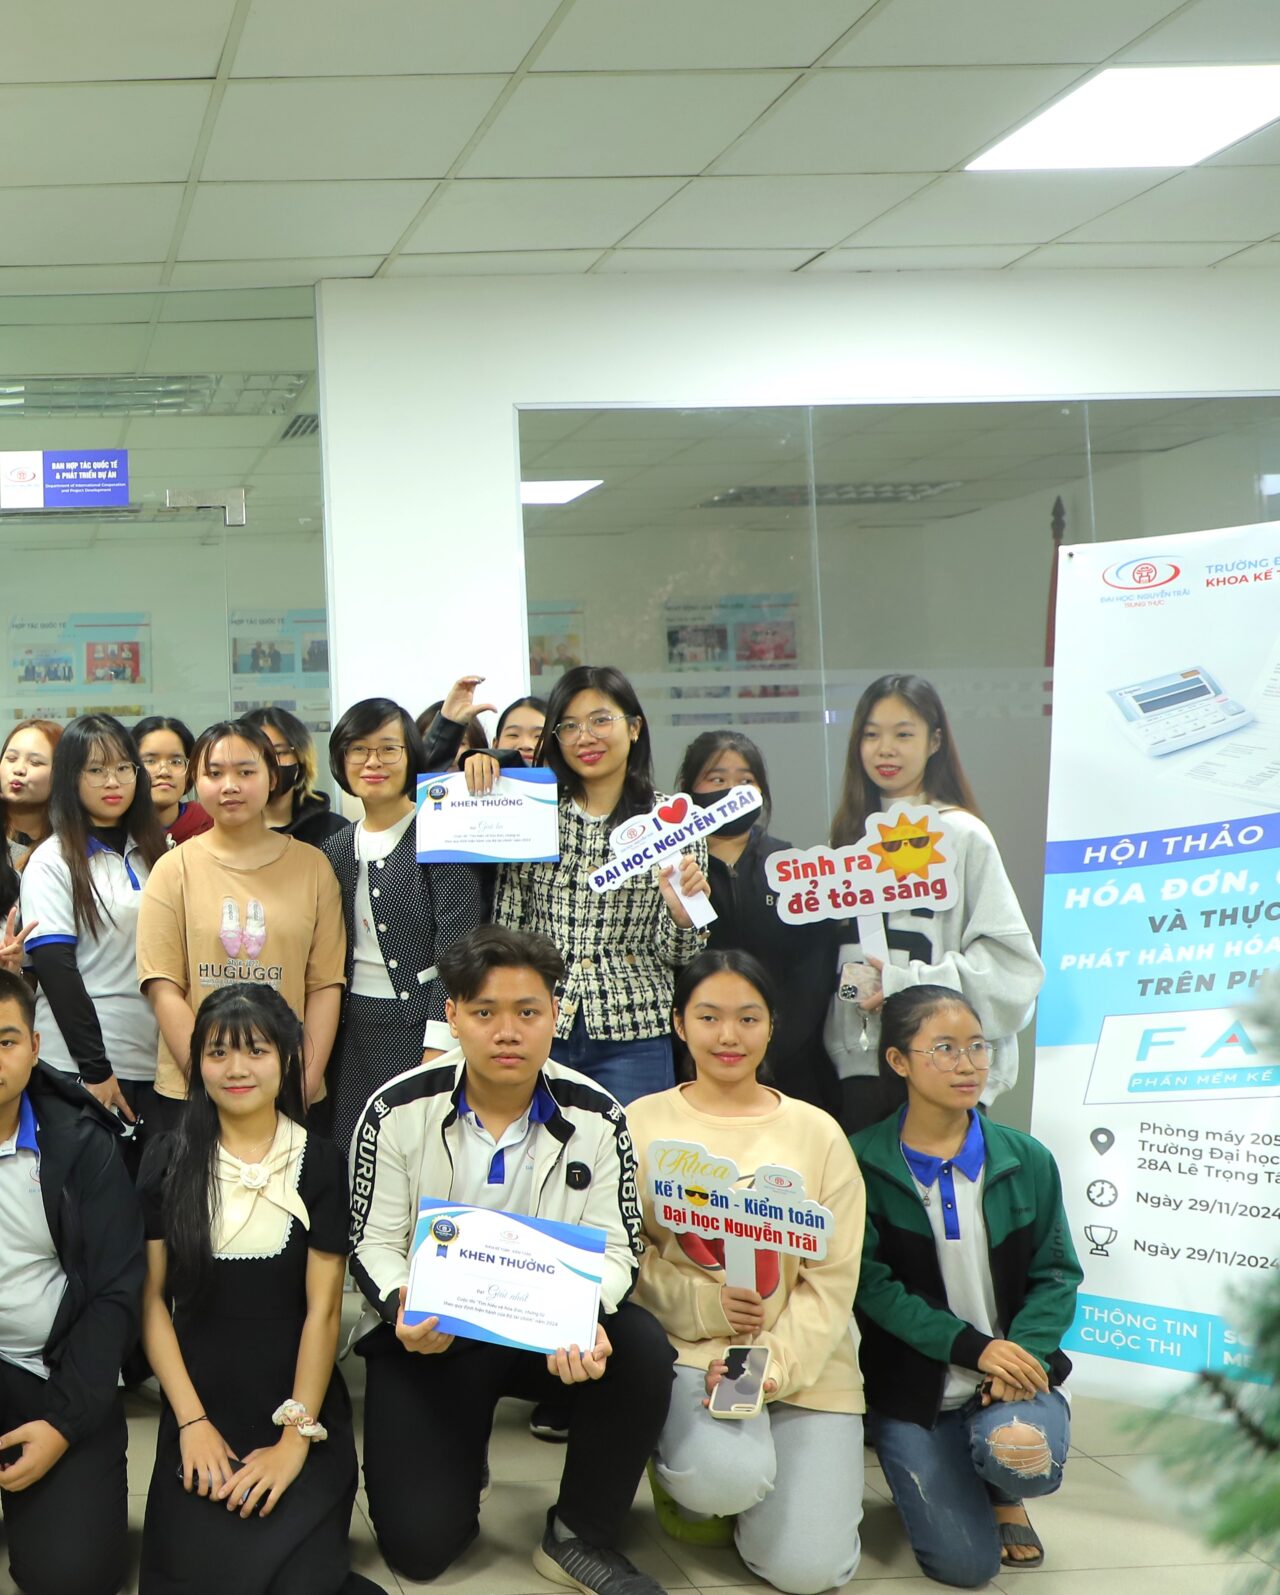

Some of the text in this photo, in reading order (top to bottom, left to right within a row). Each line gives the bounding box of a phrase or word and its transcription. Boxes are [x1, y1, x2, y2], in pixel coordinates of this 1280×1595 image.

[52, 462, 65, 470] BAN
[80, 460, 91, 469] TÁC
[111, 459, 118, 468] TẾ
[62, 470, 78, 479] PHÁT
[108, 470, 116, 478] ÁN
[1206, 558, 1269, 575] TRƯỜNG
[1206, 568, 1273, 588] KHOA KẾ
[450, 798, 523, 808] KHEN THƯỞNG
[652, 818, 663, 832] I
[594, 791, 756, 888] ĐẠI HỌC NGUYỄN TRÃI
[1084, 824, 1264, 865] HỘI THẢO
[776, 854, 873, 882] Sinh ra
[788, 874, 948, 914] để tỏa sáng
[1064, 868, 1260, 909] HÓA ĐƠN,
[1148, 900, 1280, 933] VÀ THỰC
[1060, 933, 1280, 970] PHÁT HÀNH HÓA
[1137, 970, 1216, 996] TRÊN
[1131, 1068, 1273, 1087] PHẦN MỀM KẾ
[1140, 1122, 1199, 1142] Phòng
[1206, 1130, 1245, 1146] máy
[1138, 1139, 1280, 1167] Trường Đại học
[1137, 1157, 1172, 1173] 28A
[1178, 1162, 1199, 1176] Lê
[1204, 1165, 1258, 1185] Trọng
[654, 1180, 674, 1197] Kế
[744, 1197, 784, 1221] Kiểm
[788, 1206, 825, 1230] toán
[1136, 1191, 1280, 1220] Ngày 29/11/2024
[663, 1205, 818, 1252] Đại học Nguyễn Trãi
[459, 1249, 496, 1264] KHEN
[499, 1253, 556, 1276] THƯỞNG
[1134, 1239, 1280, 1270] Ngày 29/11/2024
[1081, 1306, 1157, 1331] THÔNG
[1163, 1319, 1198, 1339] TIN
[1080, 1327, 1182, 1357] CUỘC THI
